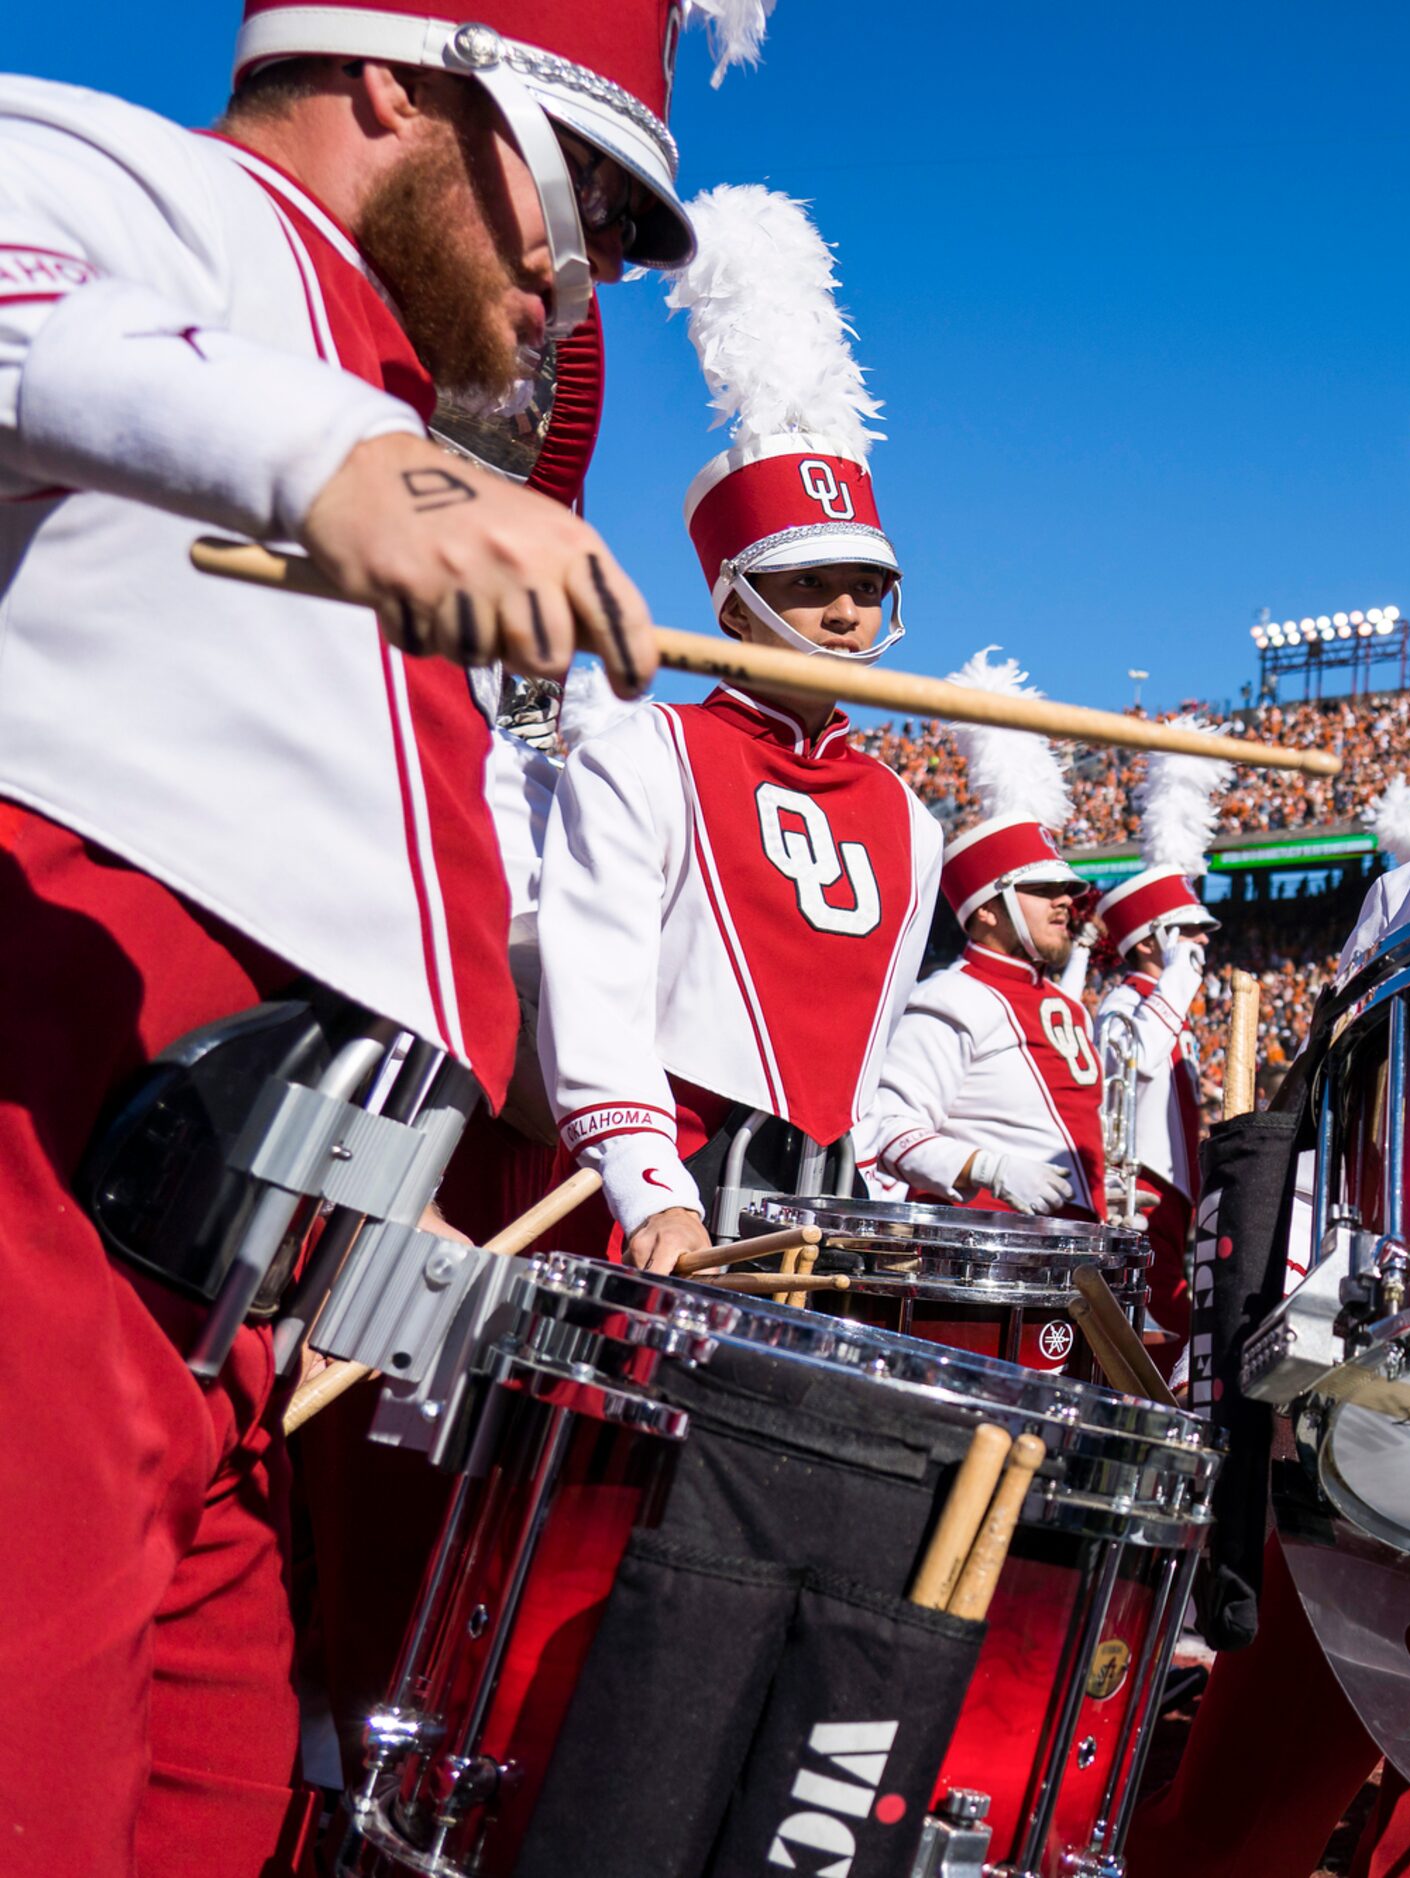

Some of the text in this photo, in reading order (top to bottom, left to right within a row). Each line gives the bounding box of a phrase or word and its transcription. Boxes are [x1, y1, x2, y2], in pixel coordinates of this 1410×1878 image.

[799, 458, 857, 522] OU
[755, 780, 882, 938] OU
[1039, 997, 1099, 1086] OU
[566, 1110, 653, 1142] OKLAHOMA
